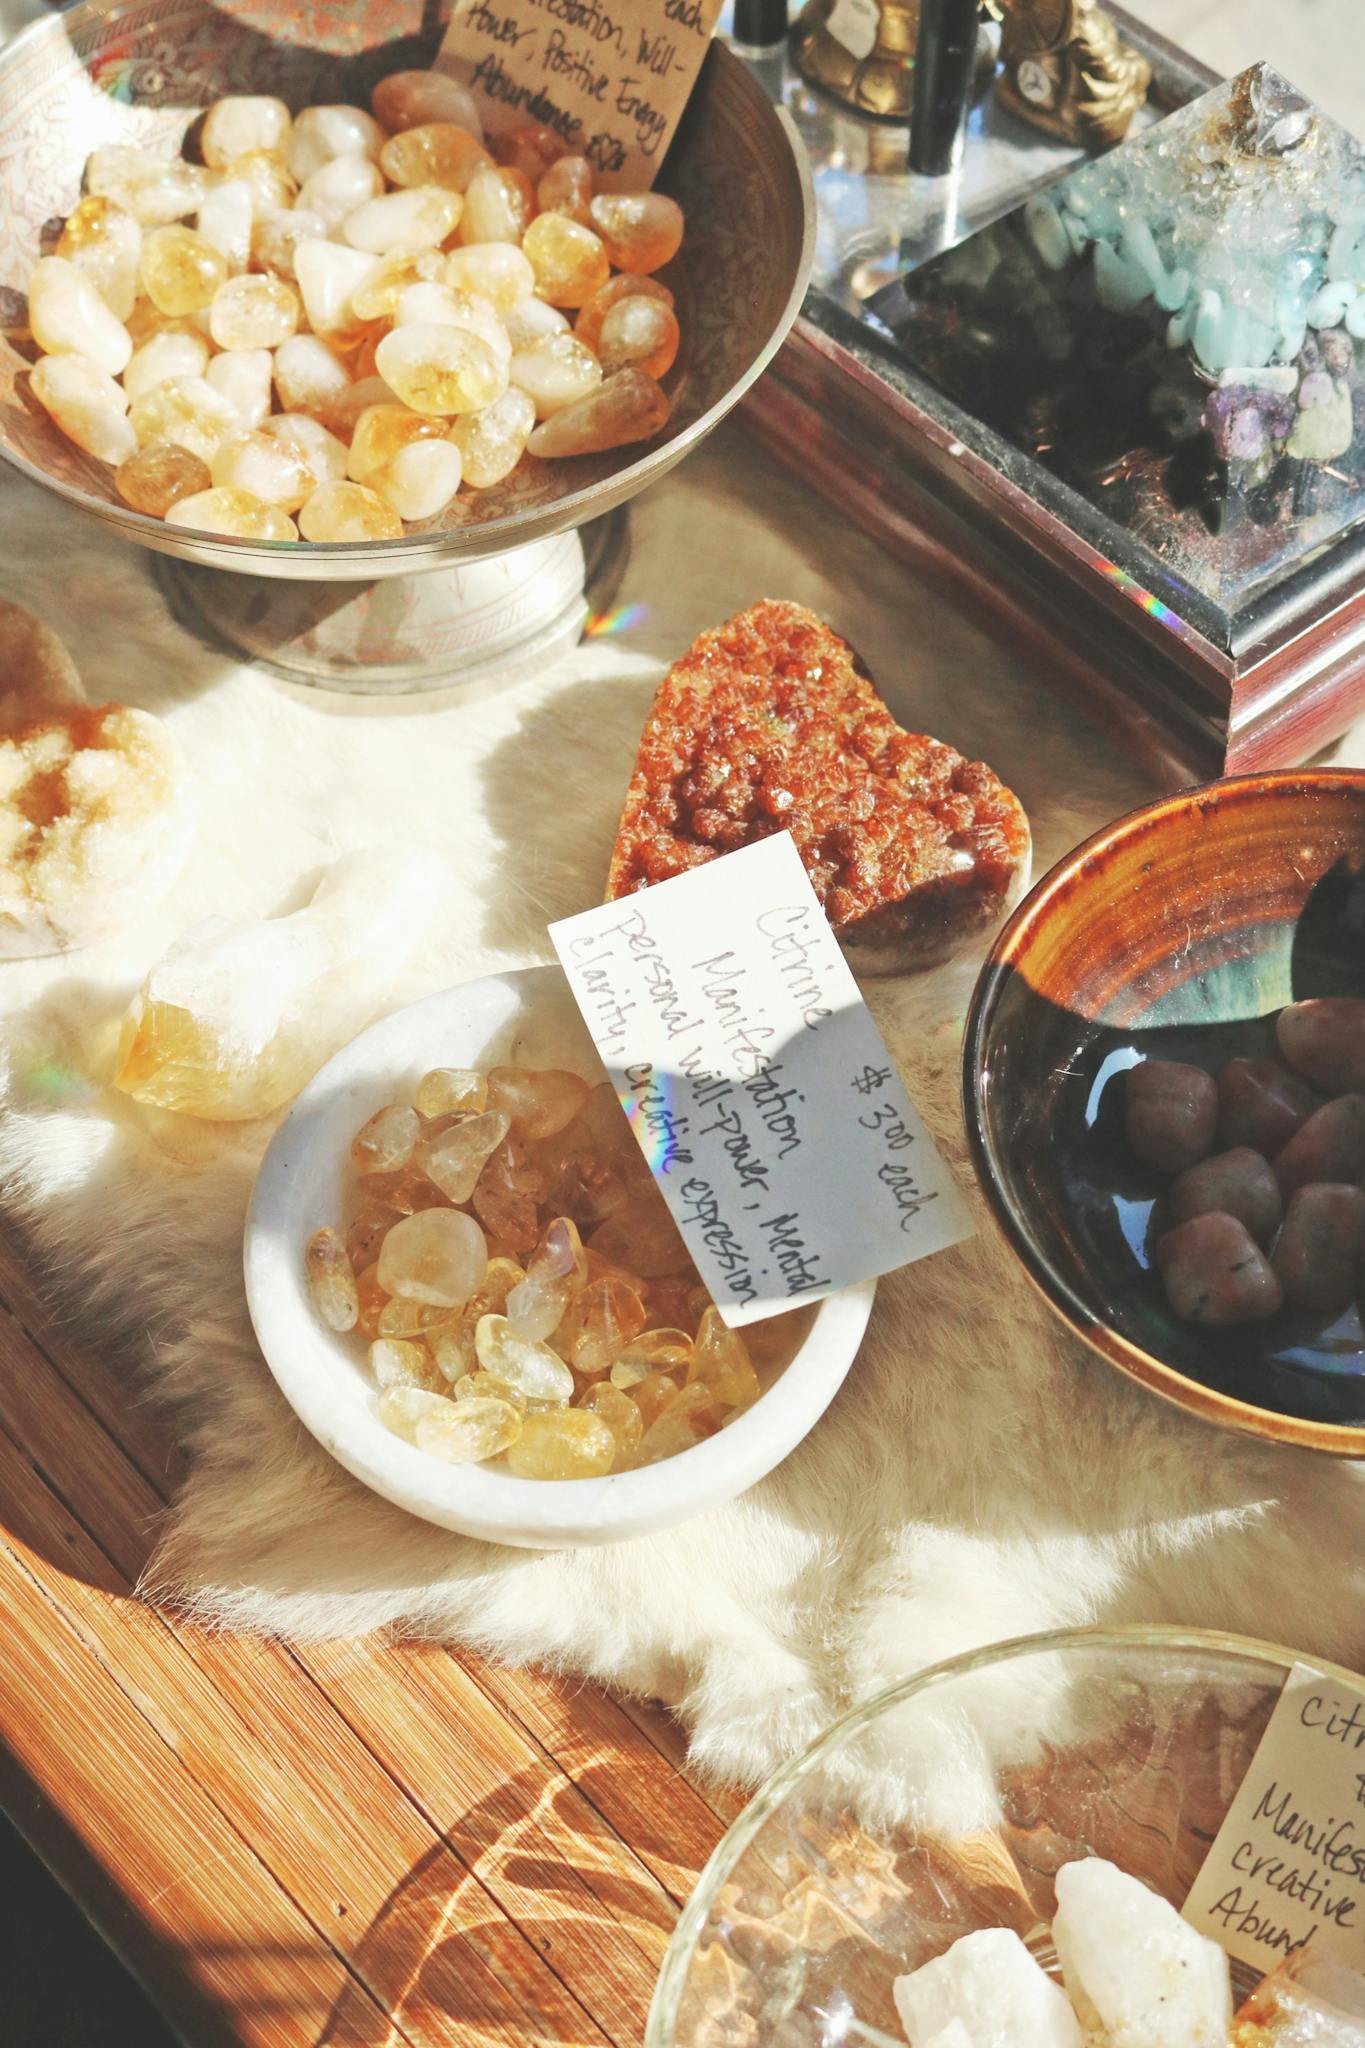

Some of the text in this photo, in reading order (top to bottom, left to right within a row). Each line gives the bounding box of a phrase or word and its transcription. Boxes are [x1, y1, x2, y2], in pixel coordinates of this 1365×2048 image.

[528, 0, 627, 57] estation,
[541, 28, 609, 101] Positive
[615, 76, 668, 156] Energy
[469, 53, 583, 145] Abundance
[690, 951, 805, 1160] Manifestation
[756, 905, 833, 1031] Citrine
[878, 1163, 939, 1233] each
[680, 1176, 768, 1310] expression
